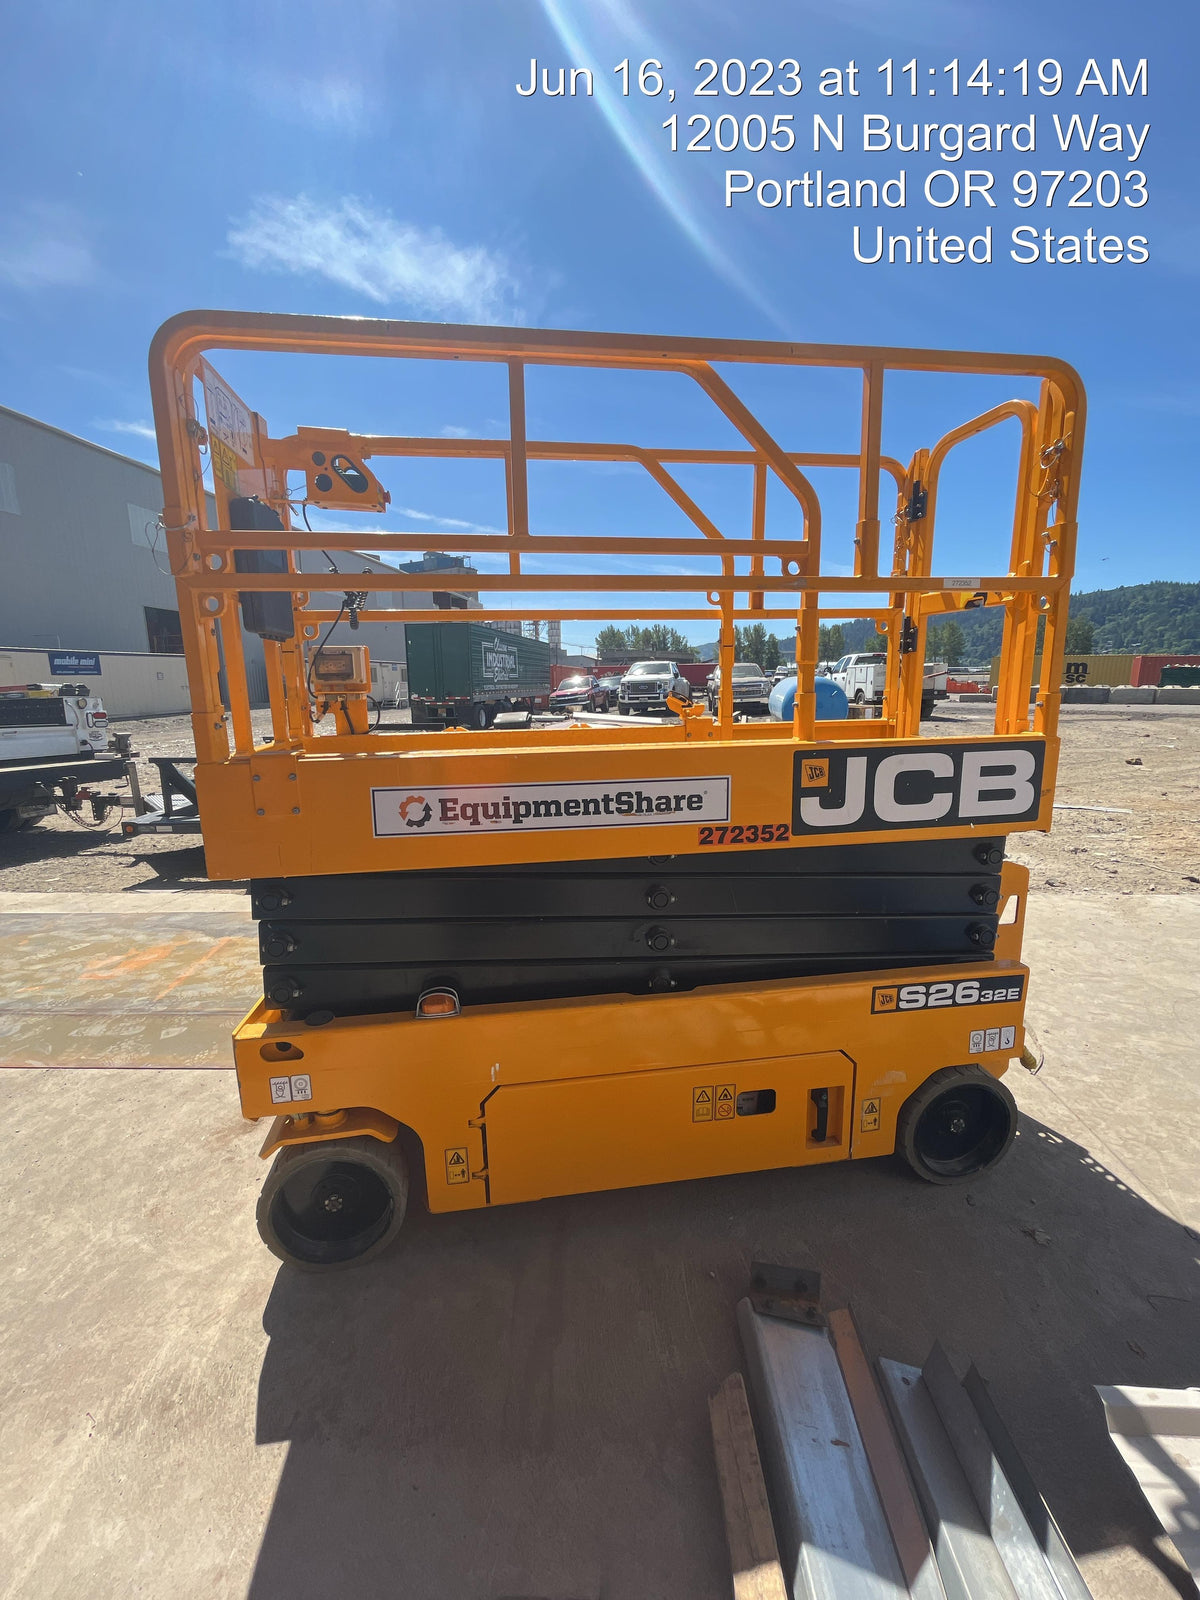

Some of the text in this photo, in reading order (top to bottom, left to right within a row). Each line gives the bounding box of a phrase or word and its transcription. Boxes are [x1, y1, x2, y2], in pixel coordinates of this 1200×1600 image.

[54, 656, 79, 665] mobile
[808, 765, 825, 780] JCB
[799, 749, 1036, 827] JCB
[438, 790, 704, 825] EquipmentShare
[699, 823, 790, 846] 272352
[898, 981, 1020, 1009] S26 32E
